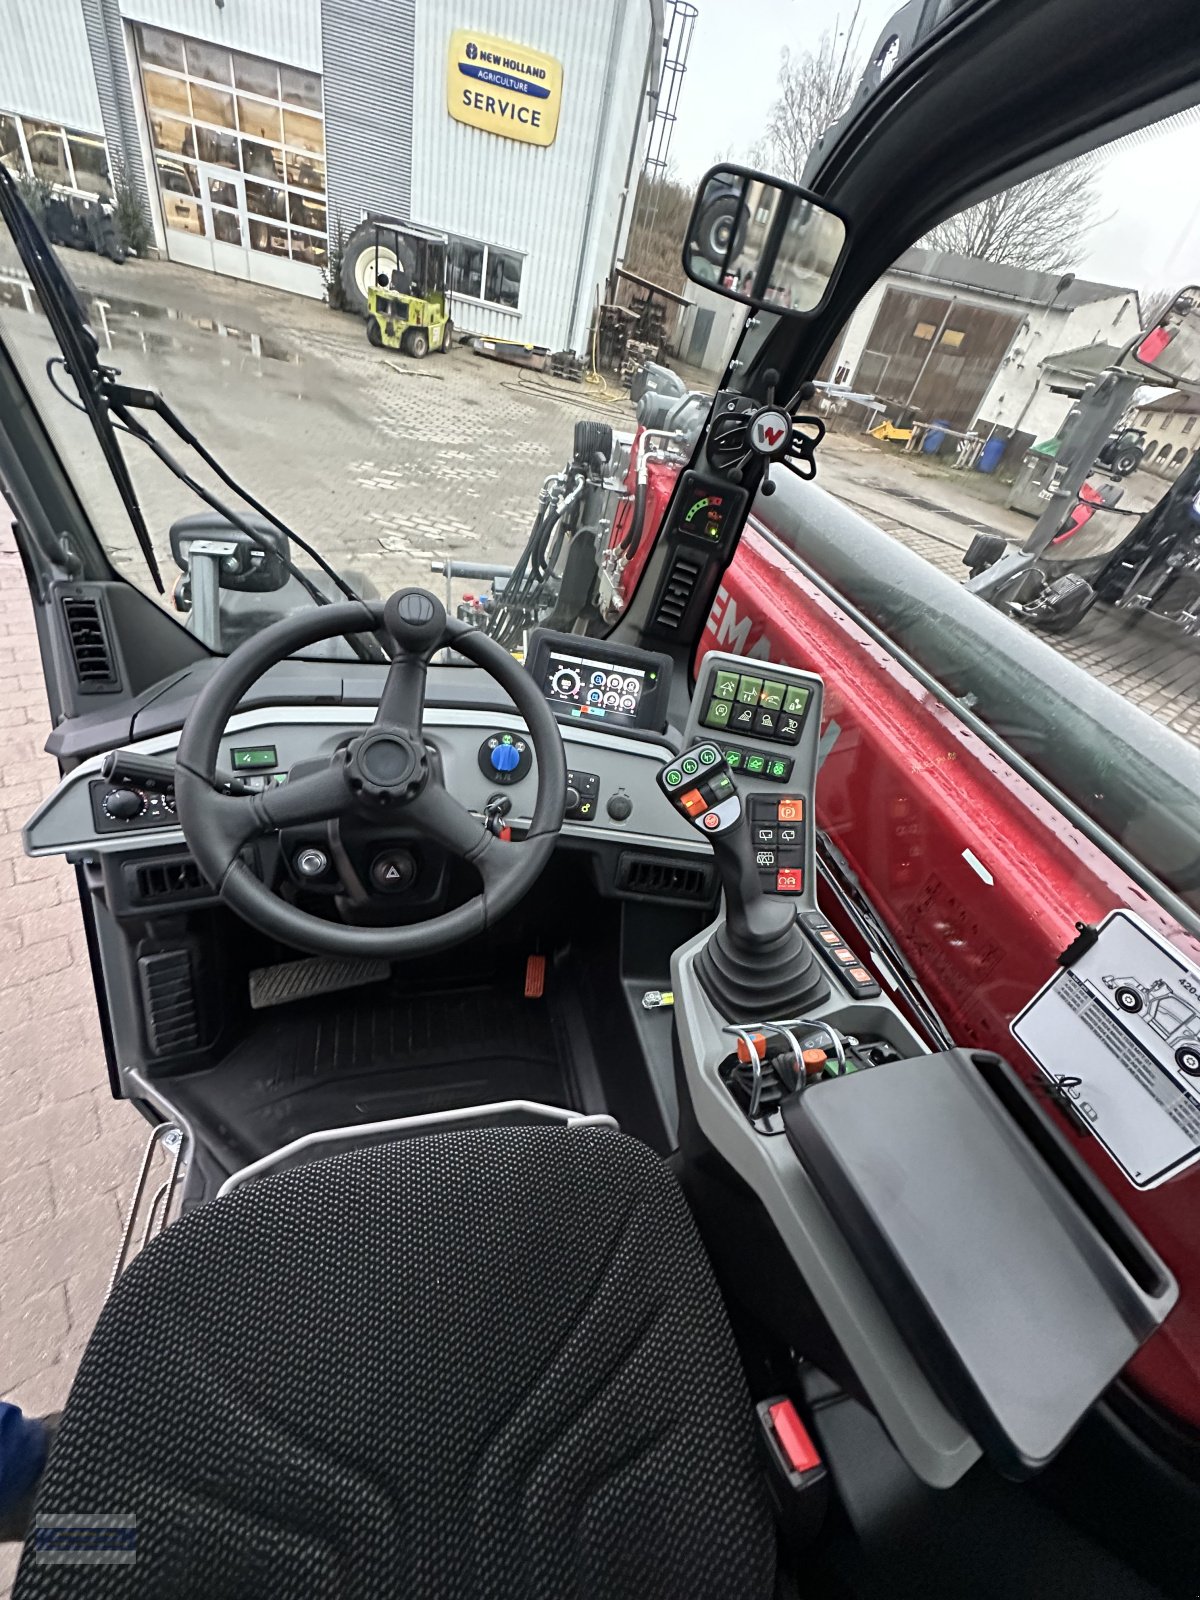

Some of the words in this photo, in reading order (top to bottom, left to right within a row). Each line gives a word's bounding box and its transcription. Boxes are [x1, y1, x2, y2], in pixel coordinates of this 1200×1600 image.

[480, 51, 501, 66] NEW
[503, 58, 546, 80] HOLLAND
[478, 70, 528, 92] AGRICULTURE
[463, 89, 541, 128] SERVICE
